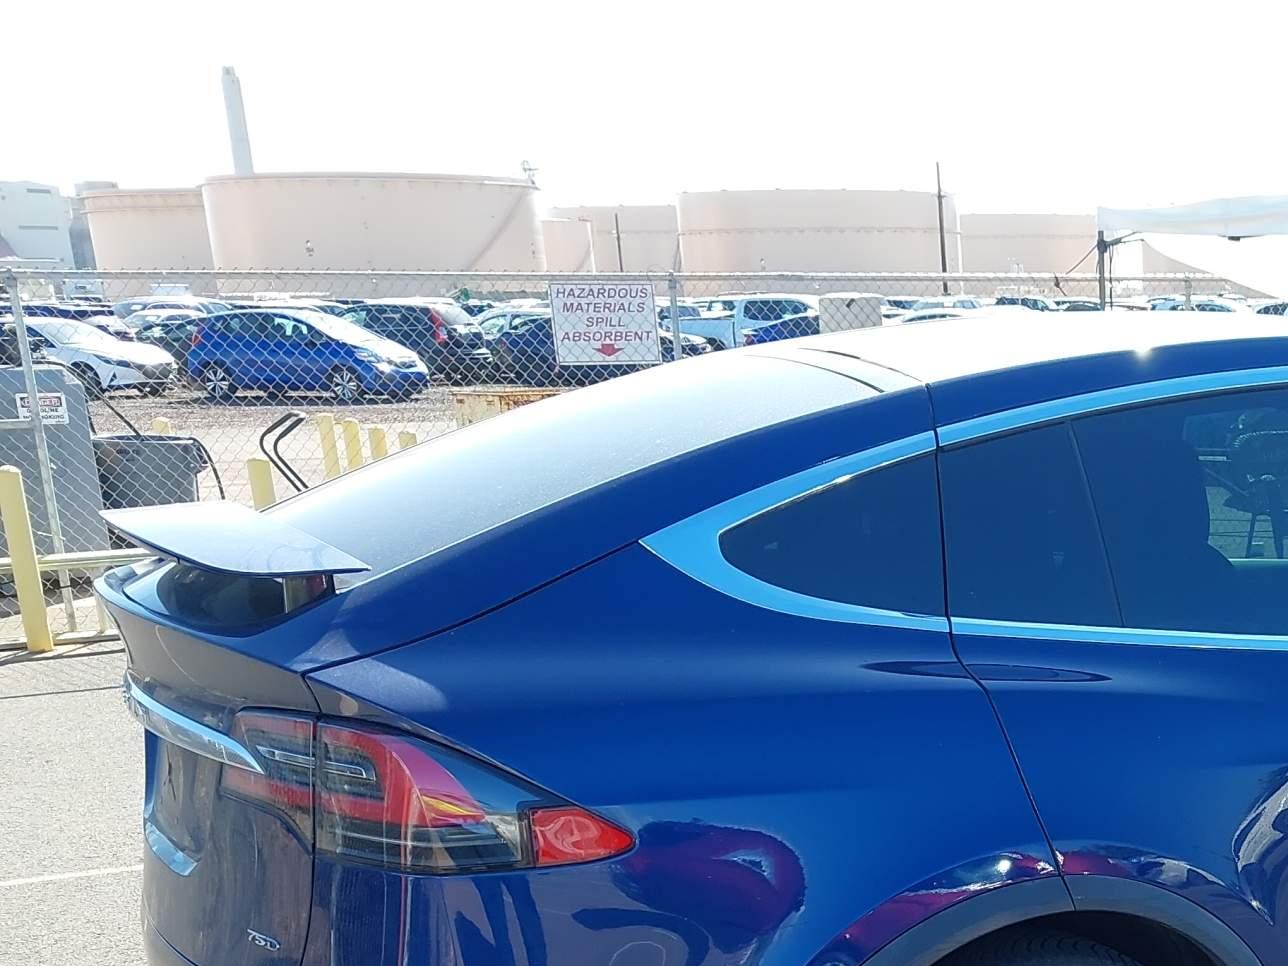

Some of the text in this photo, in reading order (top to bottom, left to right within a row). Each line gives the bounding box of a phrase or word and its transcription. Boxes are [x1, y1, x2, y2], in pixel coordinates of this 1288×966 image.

[556, 288, 648, 298] HAZARDOUS
[562, 302, 645, 313] MATERIALS
[585, 317, 626, 327] SPILL
[560, 331, 653, 342] ABSORBENT
[247, 928, 280, 950] 75D
